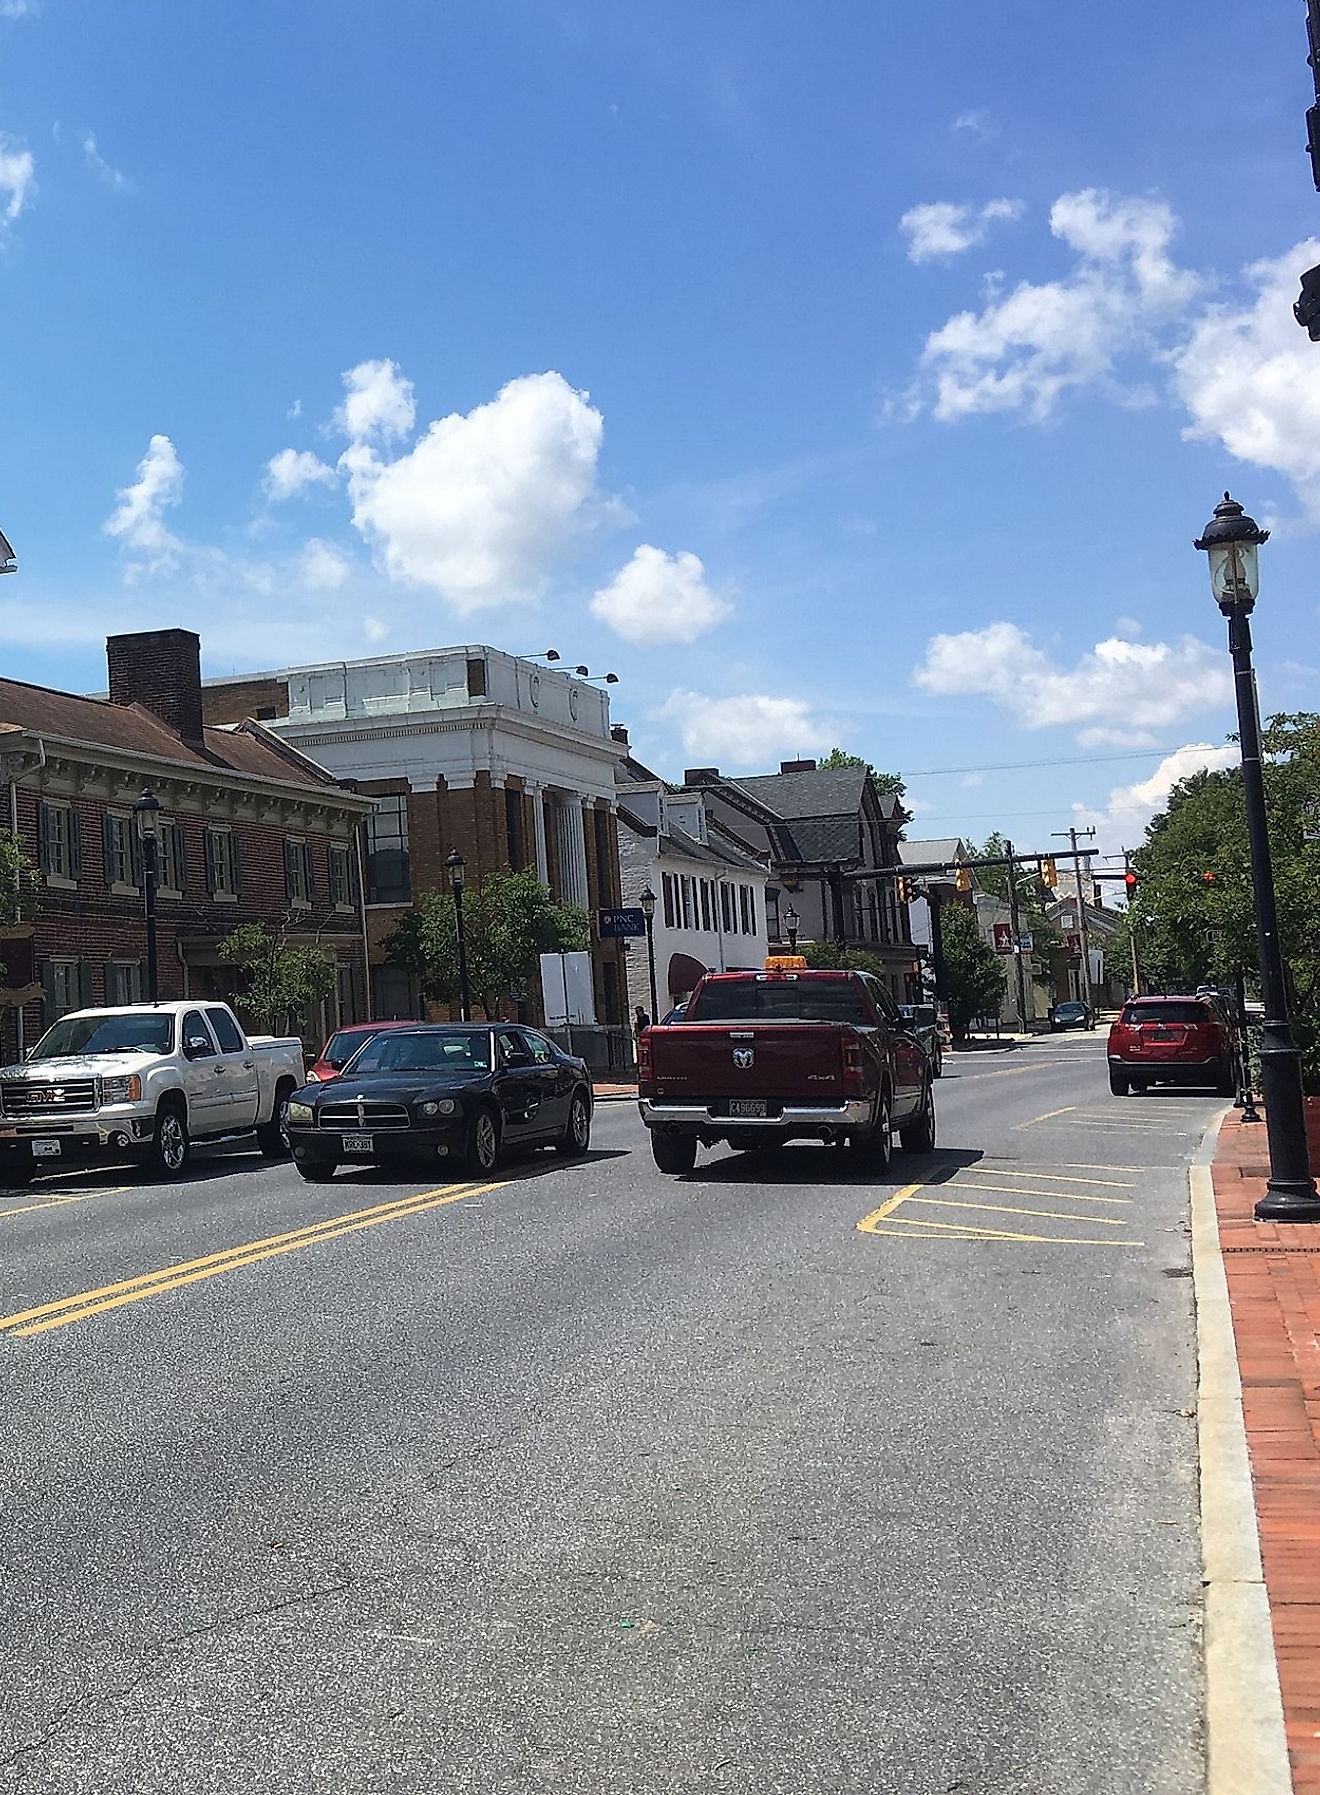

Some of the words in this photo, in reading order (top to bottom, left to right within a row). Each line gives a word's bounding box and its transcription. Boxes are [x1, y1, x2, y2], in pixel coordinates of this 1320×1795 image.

[613, 915, 634, 923] PNC
[614, 923, 640, 931] BANK
[26, 1089, 66, 1103] GMC
